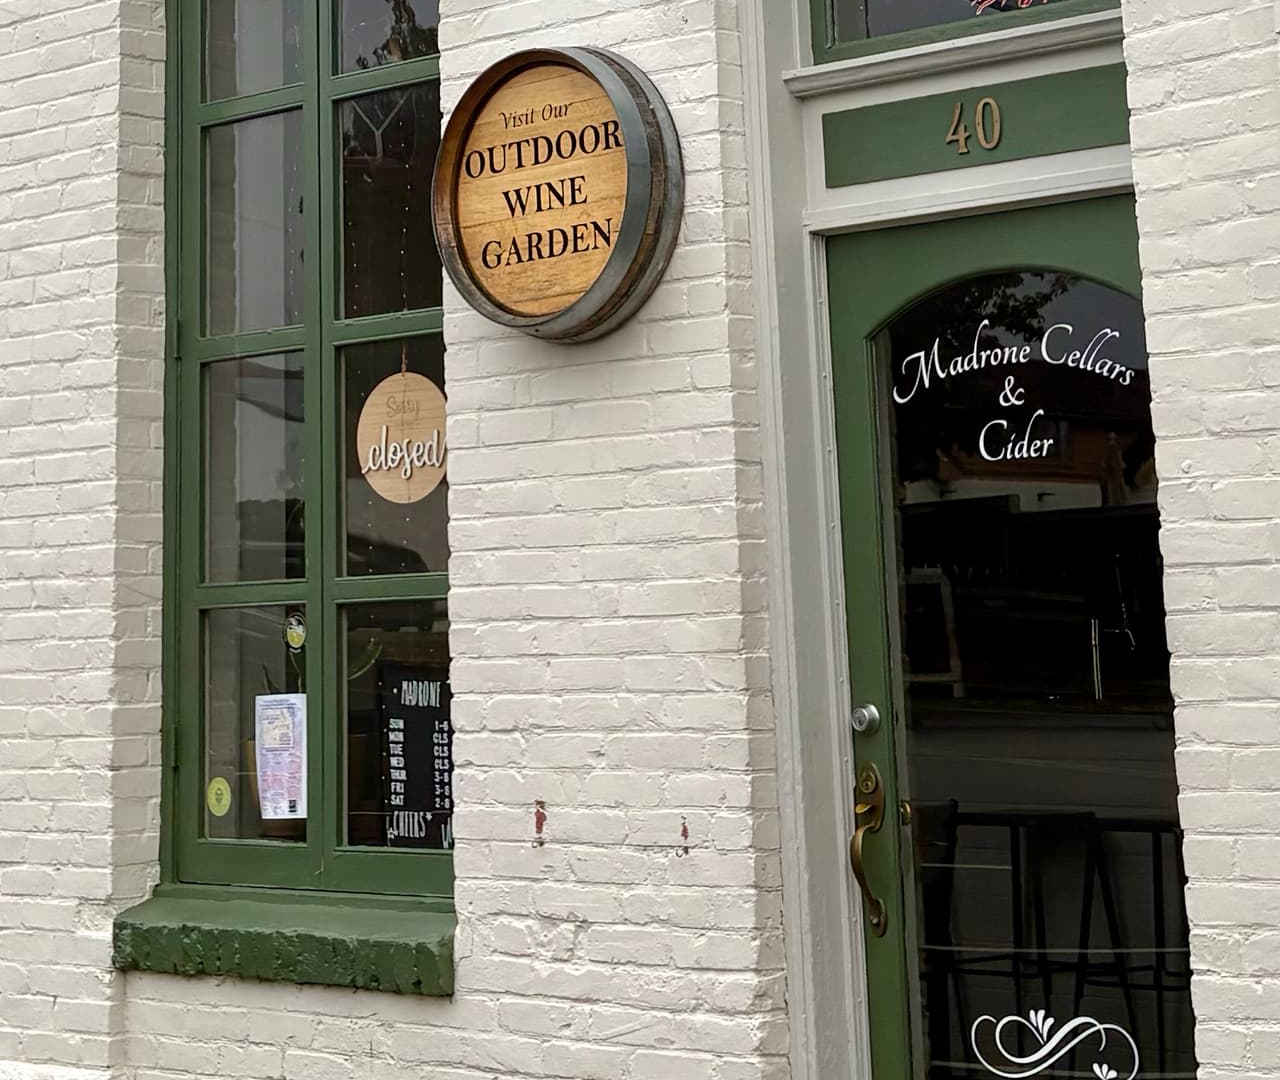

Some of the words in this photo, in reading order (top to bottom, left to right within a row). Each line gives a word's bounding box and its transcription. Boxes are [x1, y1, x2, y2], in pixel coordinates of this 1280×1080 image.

[498, 106, 535, 130] Visit
[541, 101, 574, 122] Our
[945, 96, 1004, 155] 40
[464, 119, 625, 179] OUTDOOR
[502, 175, 588, 218] WINE
[481, 218, 614, 270] GARDEN
[892, 319, 1032, 405] Madrone
[1041, 323, 1135, 387] Cellars
[998, 375, 1025, 407] &
[361, 424, 448, 479] closed
[978, 409, 1055, 462] Cider
[401, 680, 441, 708] MADRONE
[390, 781, 405, 793] FRI
[390, 794, 405, 806] SAT
